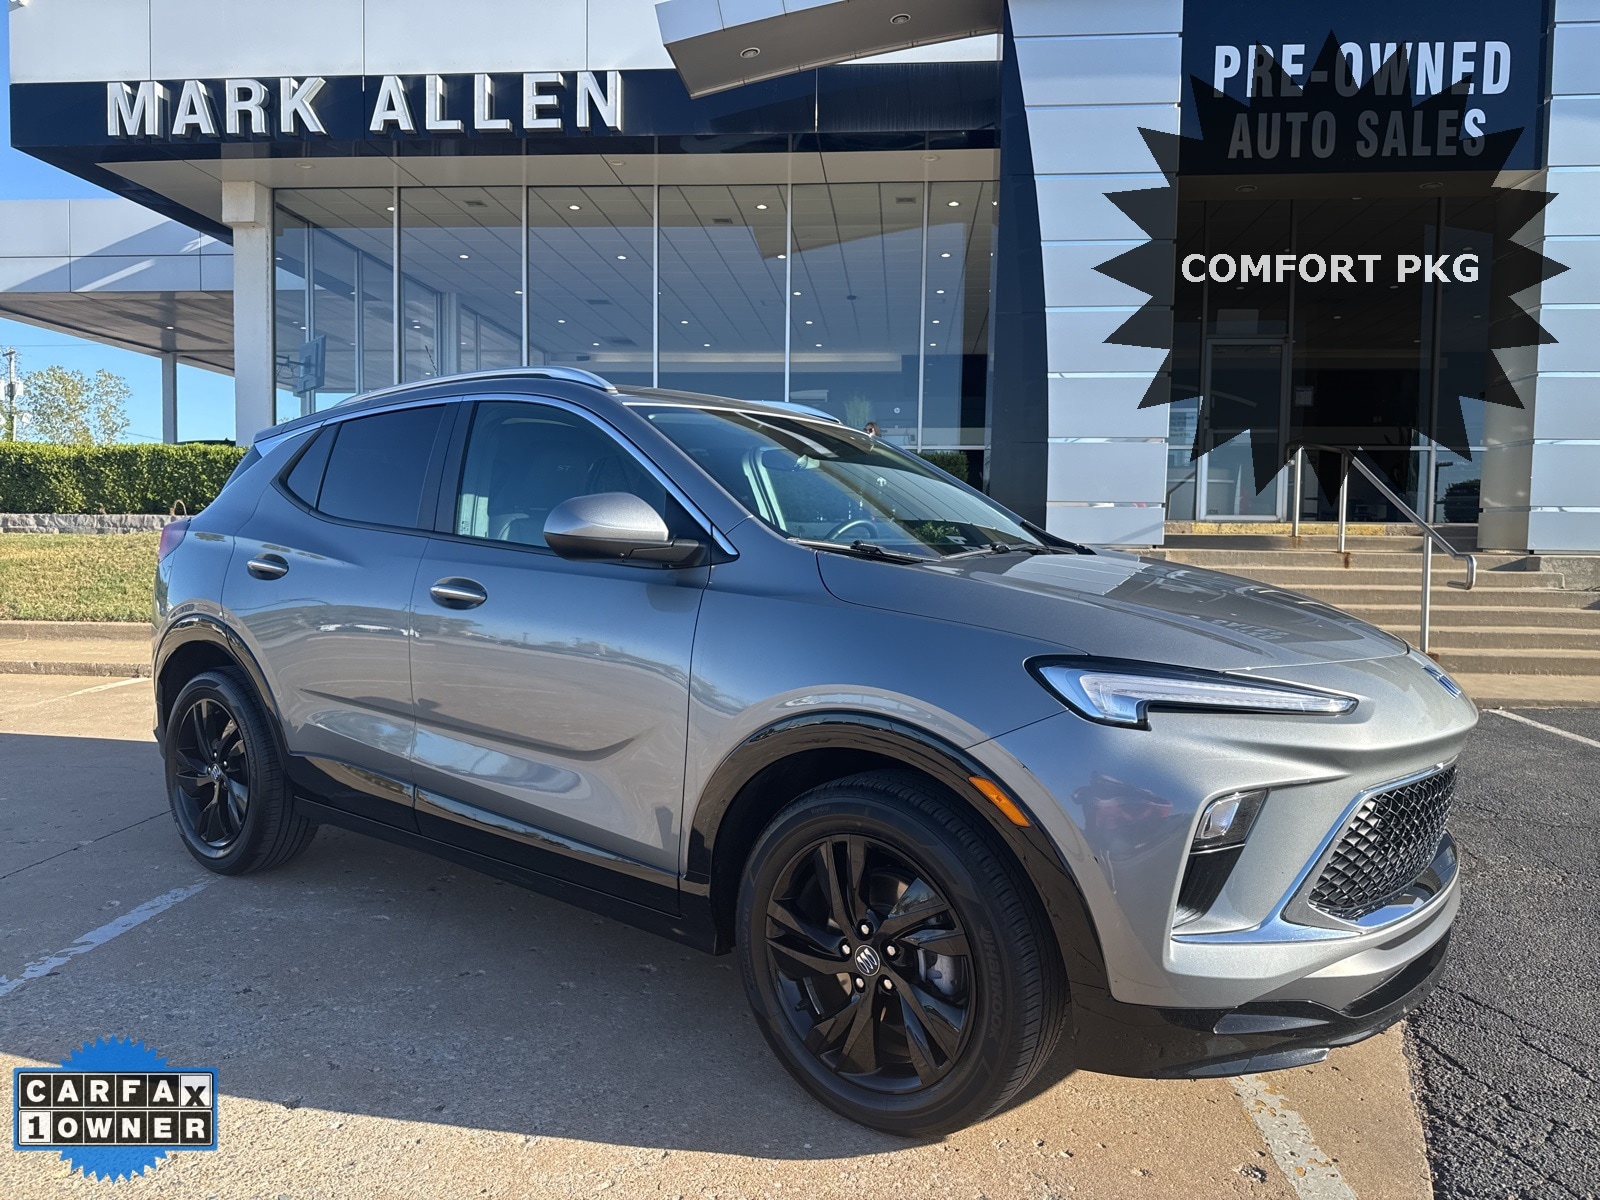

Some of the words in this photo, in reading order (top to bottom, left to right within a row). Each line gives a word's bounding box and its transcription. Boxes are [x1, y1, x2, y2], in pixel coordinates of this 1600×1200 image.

[1213, 41, 1511, 97] PRE-OWNED
[107, 77, 326, 137] MARK
[369, 71, 624, 133] ALLEN
[1227, 110, 1336, 159] AUTO
[1356, 108, 1486, 157] SALES
